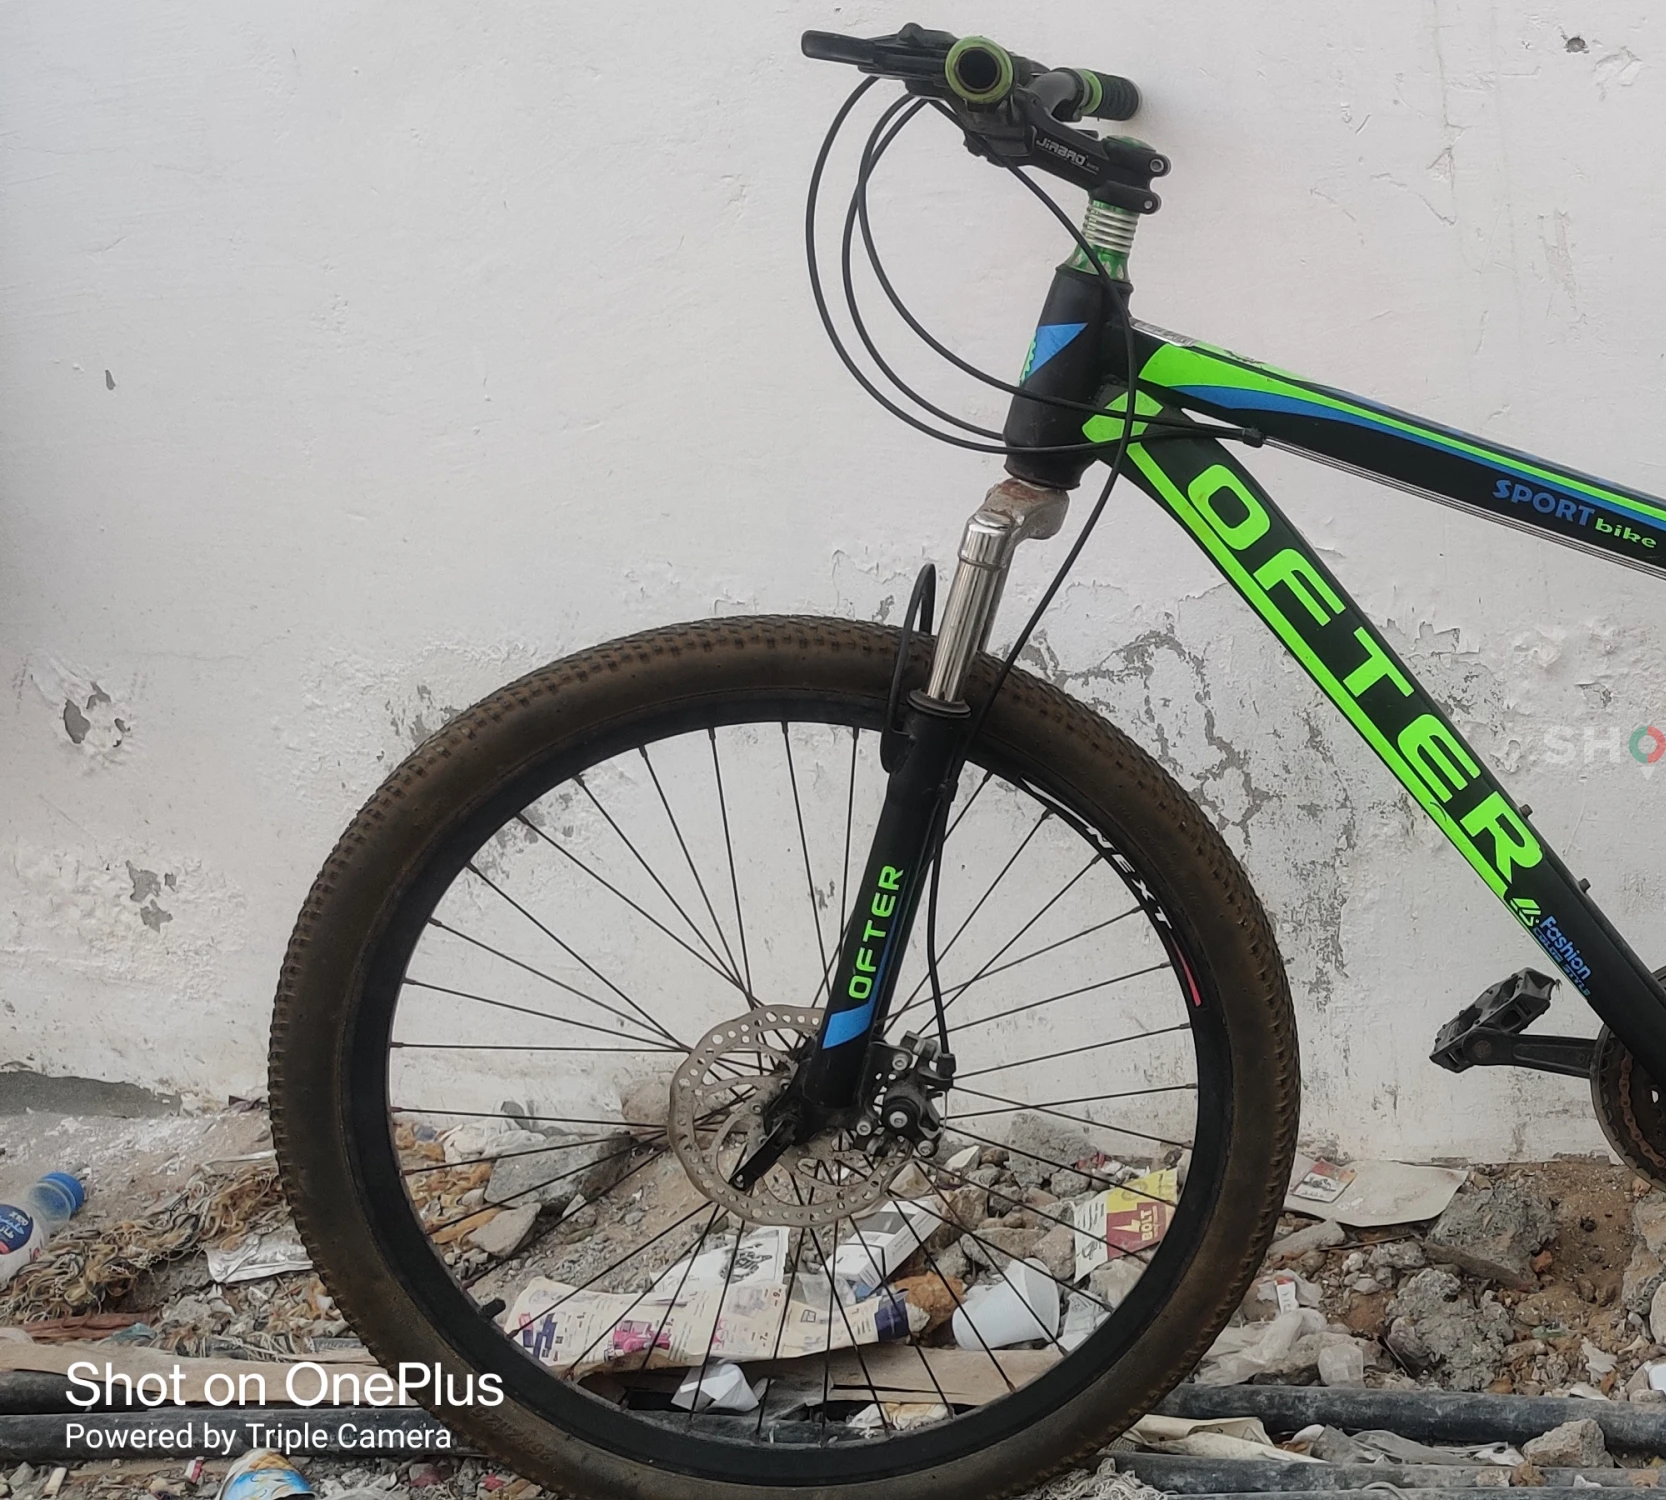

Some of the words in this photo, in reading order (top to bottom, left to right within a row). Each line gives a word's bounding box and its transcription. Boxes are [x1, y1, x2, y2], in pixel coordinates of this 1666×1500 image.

[1493, 479, 1596, 526] SPORT
[1595, 517, 1657, 548] bike
[1187, 464, 1544, 883] OFTER
[1085, 826, 1173, 930] NEXT
[848, 865, 904, 999] OFTER
[1539, 915, 1592, 980] Fashion
[1140, 1209, 1154, 1241] BOLT
